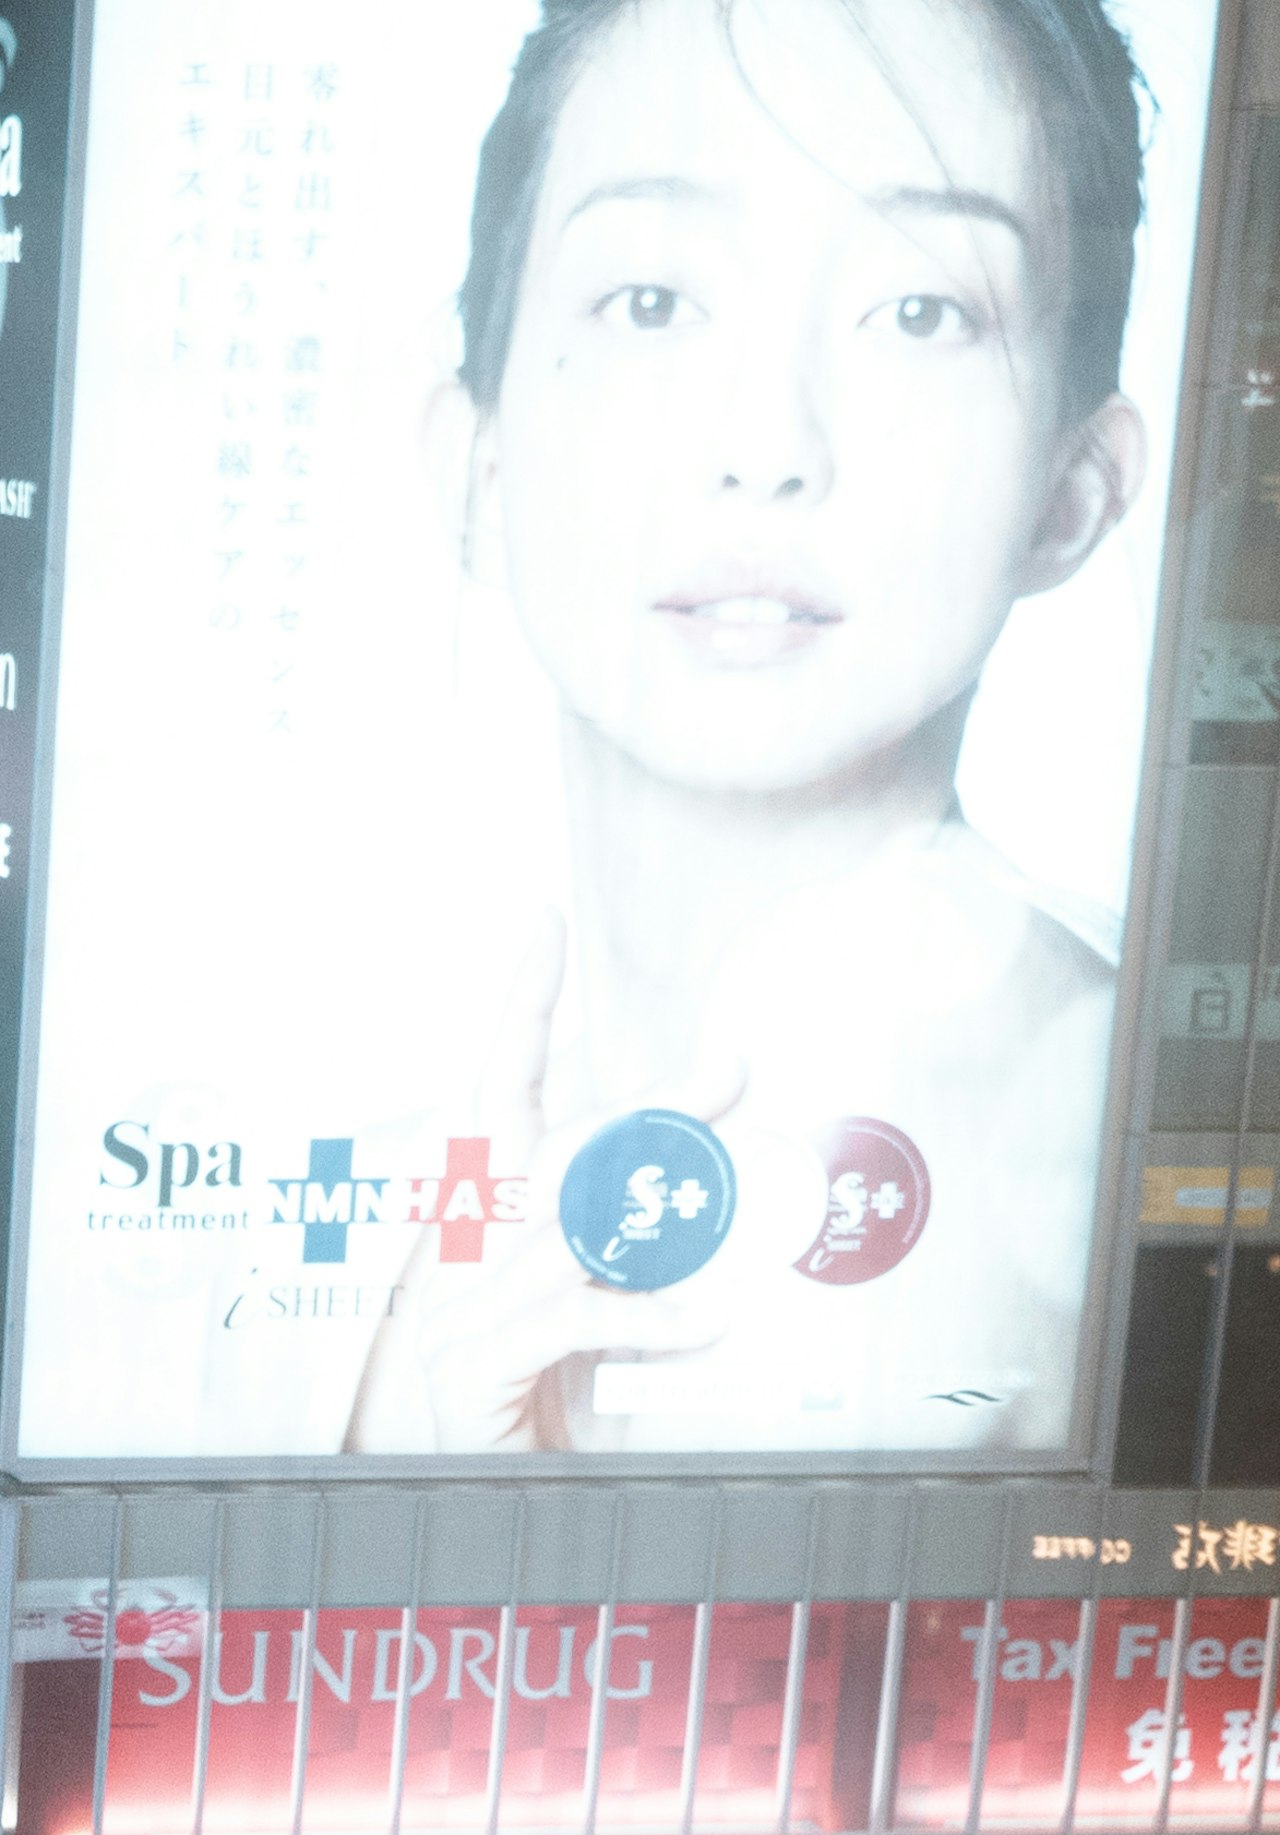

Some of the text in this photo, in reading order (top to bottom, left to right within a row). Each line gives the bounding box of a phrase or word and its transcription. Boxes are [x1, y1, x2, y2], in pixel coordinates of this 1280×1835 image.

[98, 1120, 244, 1208] Spa
[87, 1208, 250, 1232] treatment
[270, 1178, 388, 1223] NMN
[266, 1285, 405, 1318] SHEET
[138, 1623, 652, 1707] SUNDRUG
[960, 1623, 1272, 1682] Tax Free
